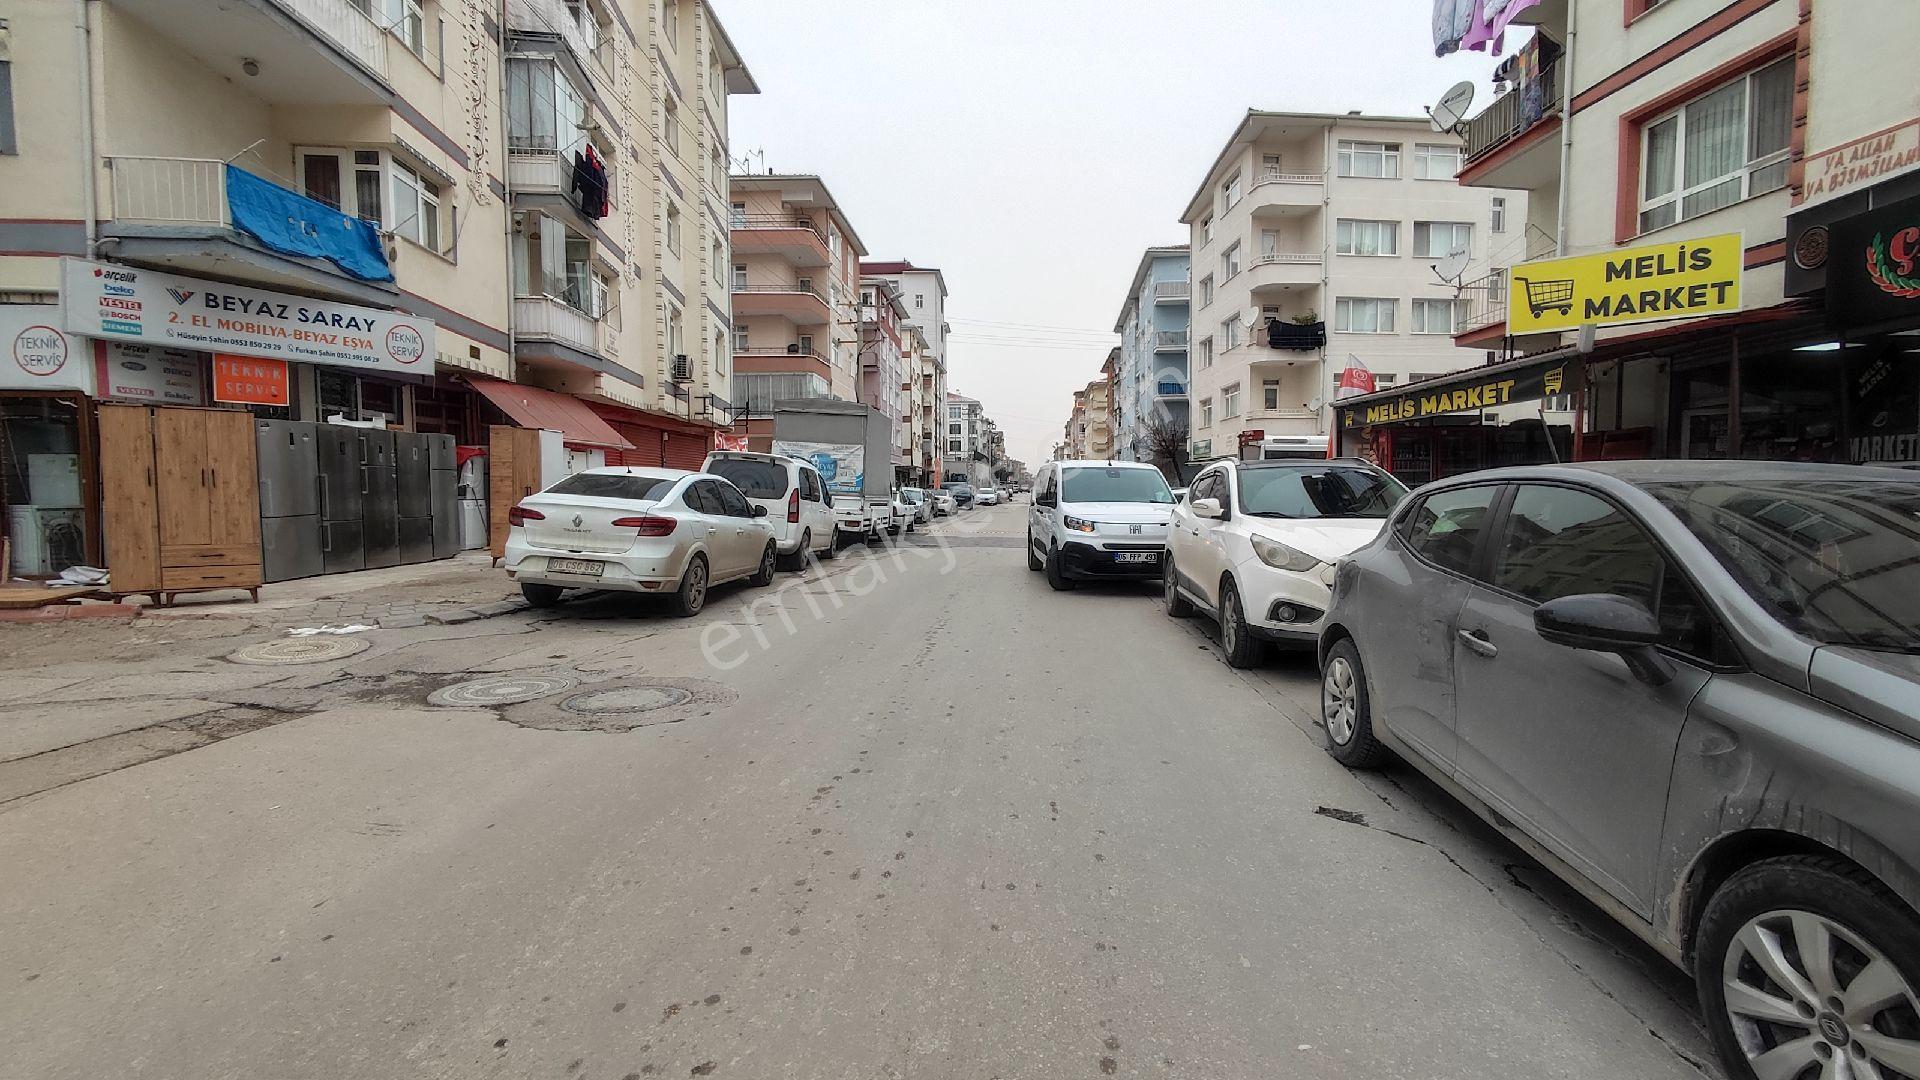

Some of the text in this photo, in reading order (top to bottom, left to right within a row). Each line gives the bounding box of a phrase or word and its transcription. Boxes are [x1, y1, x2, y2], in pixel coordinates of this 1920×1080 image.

[1605, 245, 1712, 283] MELİS
[104, 269, 138, 284] arçelik
[104, 283, 135, 293] beko
[100, 296, 142, 311] VESTEL
[1584, 280, 1734, 320] MARKET
[111, 312, 141, 321] BOSCH
[205, 292, 376, 333] BEYAZ SARAY
[103, 321, 142, 333] SIEMENS
[168, 311, 185, 324] 2.
[192, 314, 212, 328] EL
[343, 336, 373, 351] EŞYA
[20, 334, 60, 350] TEKNİK
[177, 331, 207, 341] Hüseyin
[391, 331, 419, 345] TEKNİK
[392, 345, 419, 358] SERVİS
[22, 352, 62, 368] SERVİS
[1421, 379, 1515, 416] MARKET
[1129, 524, 1142, 535] FIAT
